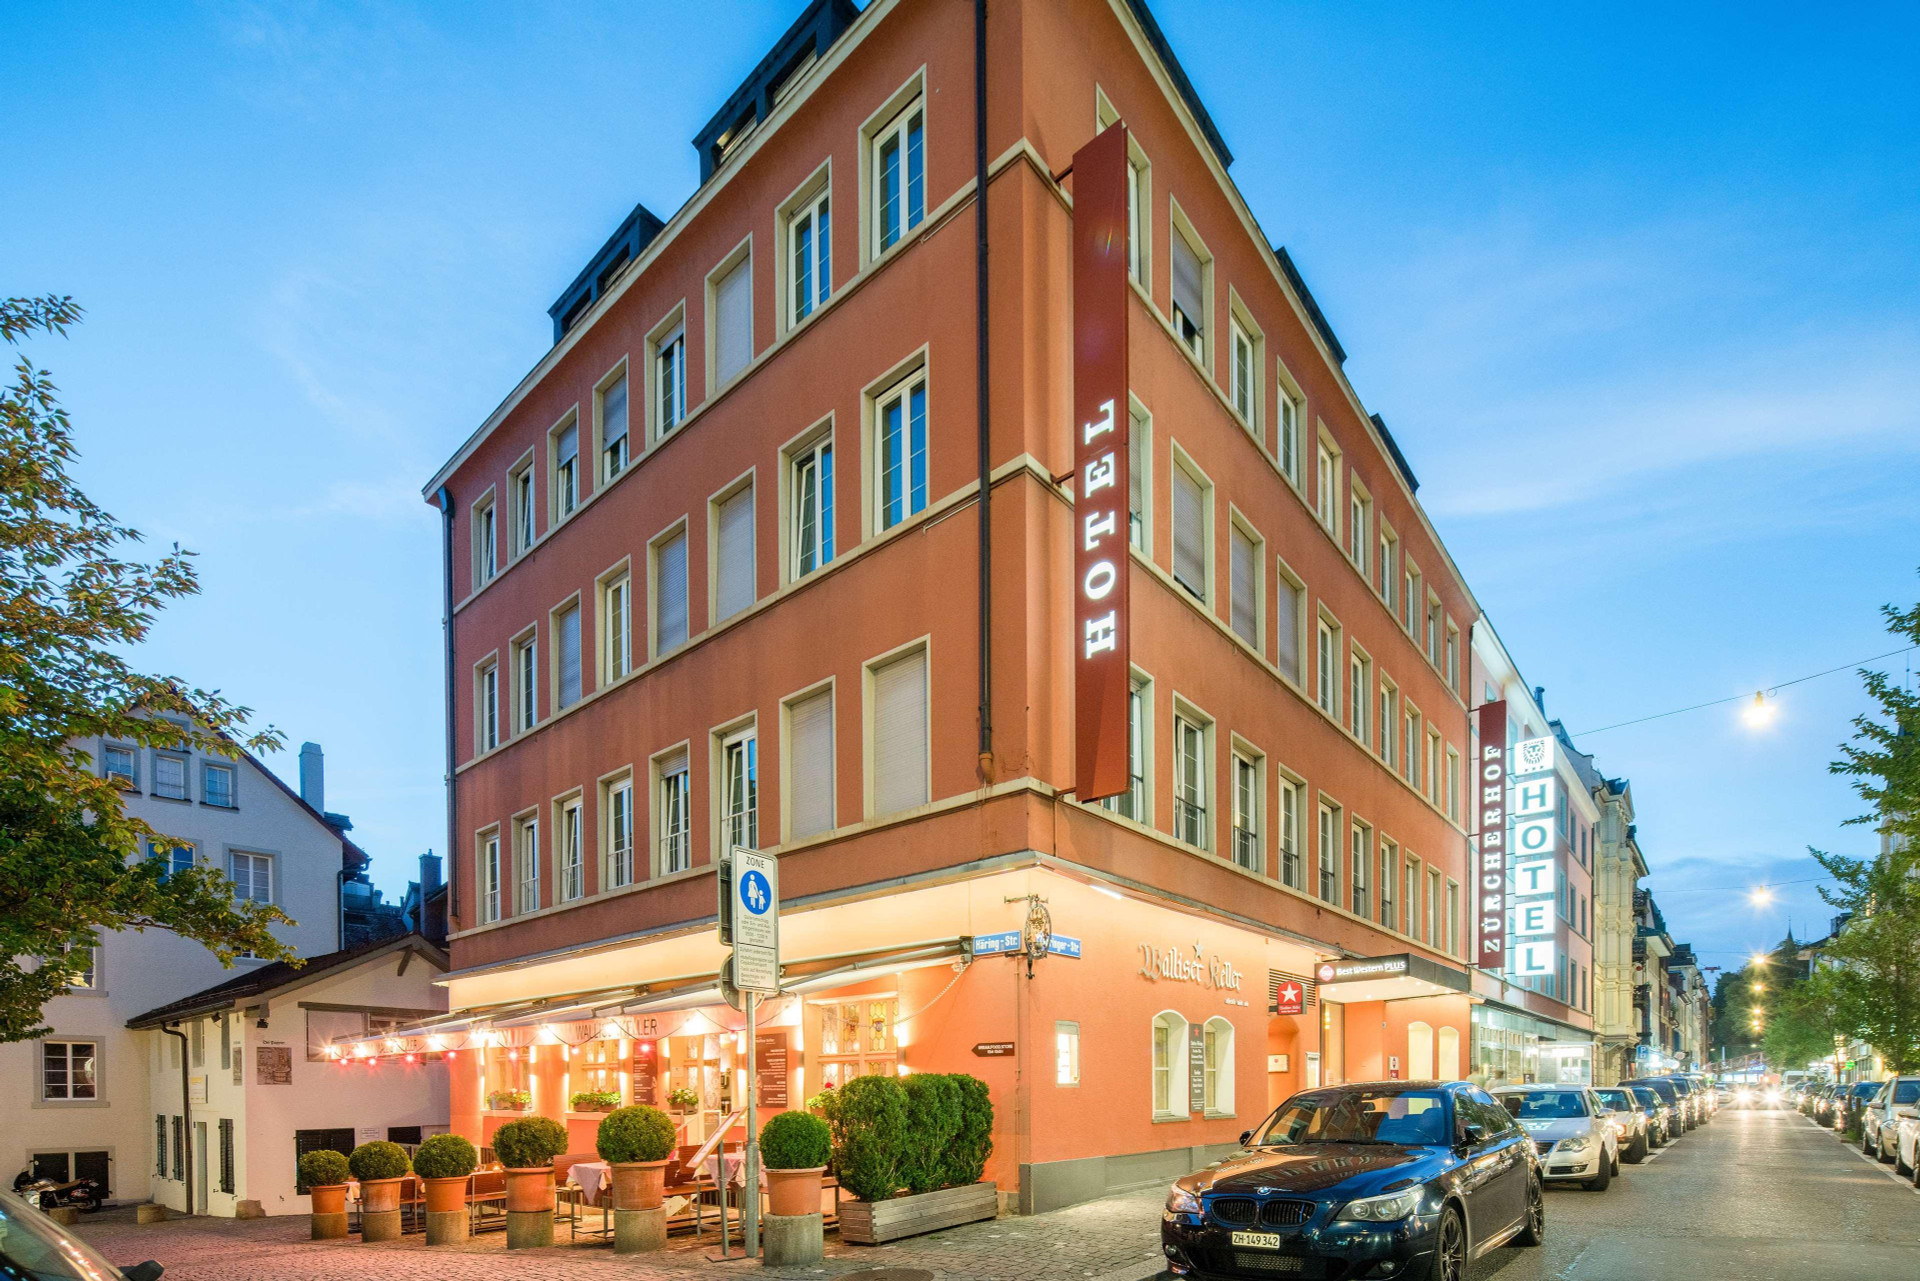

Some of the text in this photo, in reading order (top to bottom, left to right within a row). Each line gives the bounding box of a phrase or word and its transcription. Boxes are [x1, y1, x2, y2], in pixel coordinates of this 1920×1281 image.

[1084, 398, 1116, 660] HOTEL
[745, 855, 765, 869] ZONE
[1481, 745, 1502, 955] ZÜRCHERHOF
[1521, 783, 1547, 972] HOTEL
[1138, 942, 1243, 992] Walliser Keller
[1336, 967, 1353, 976] Best
[1354, 964, 1384, 975] Western
[1384, 961, 1406, 972] PLUS
